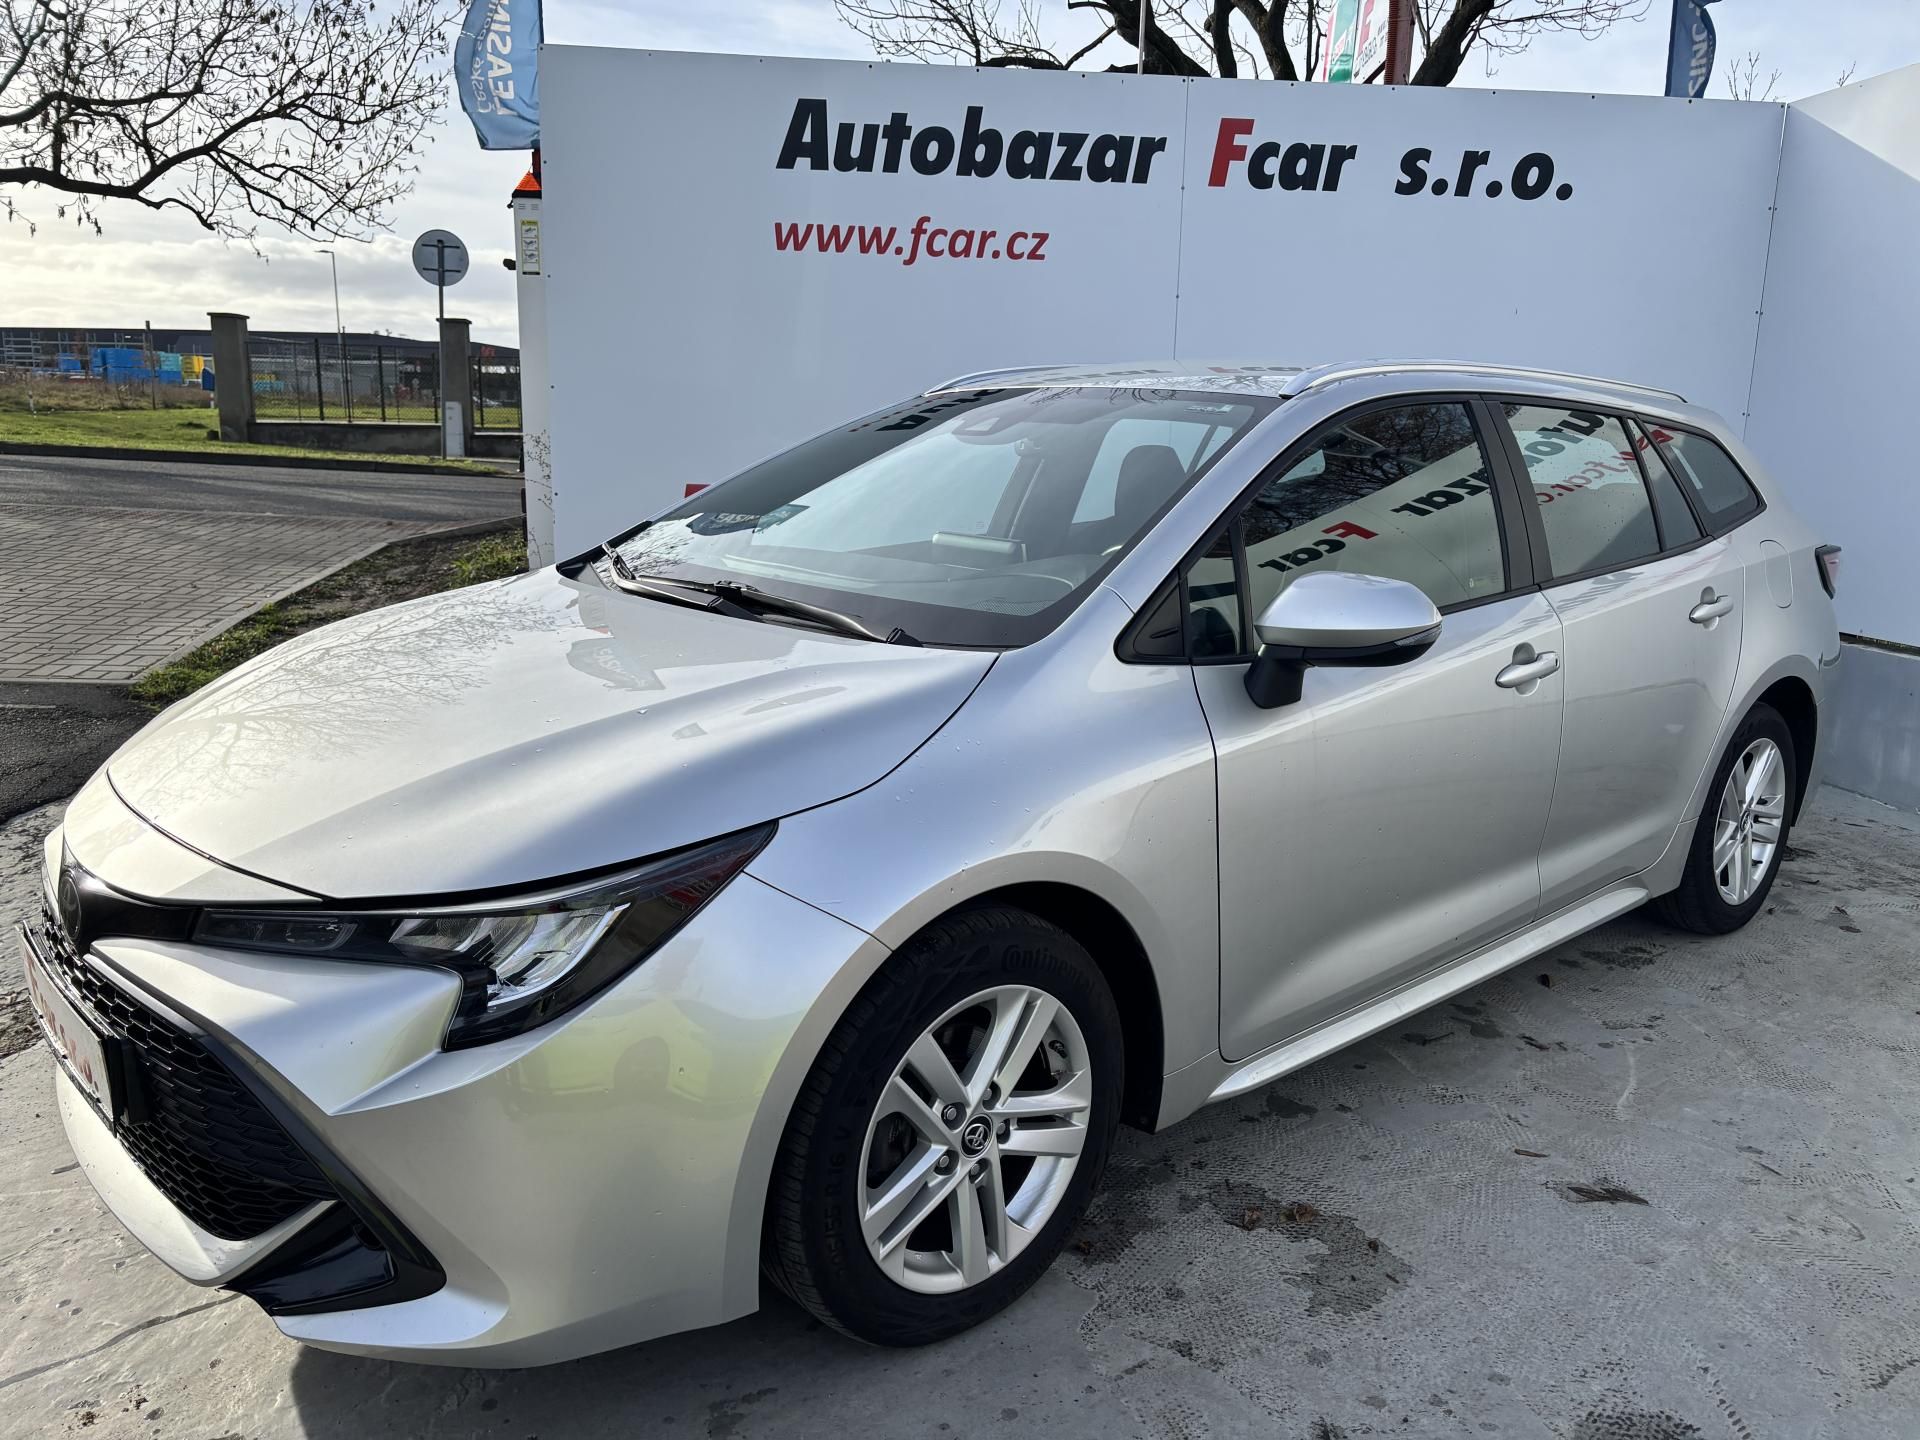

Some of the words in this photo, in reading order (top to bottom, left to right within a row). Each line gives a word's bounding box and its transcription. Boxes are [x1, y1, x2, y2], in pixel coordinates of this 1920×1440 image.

[776, 98, 1167, 184] Autobazar
[1208, 117, 1357, 192] Fcar
[1394, 147, 1574, 201] s.r.o.
[774, 216, 1050, 266] www.fcar.cz
